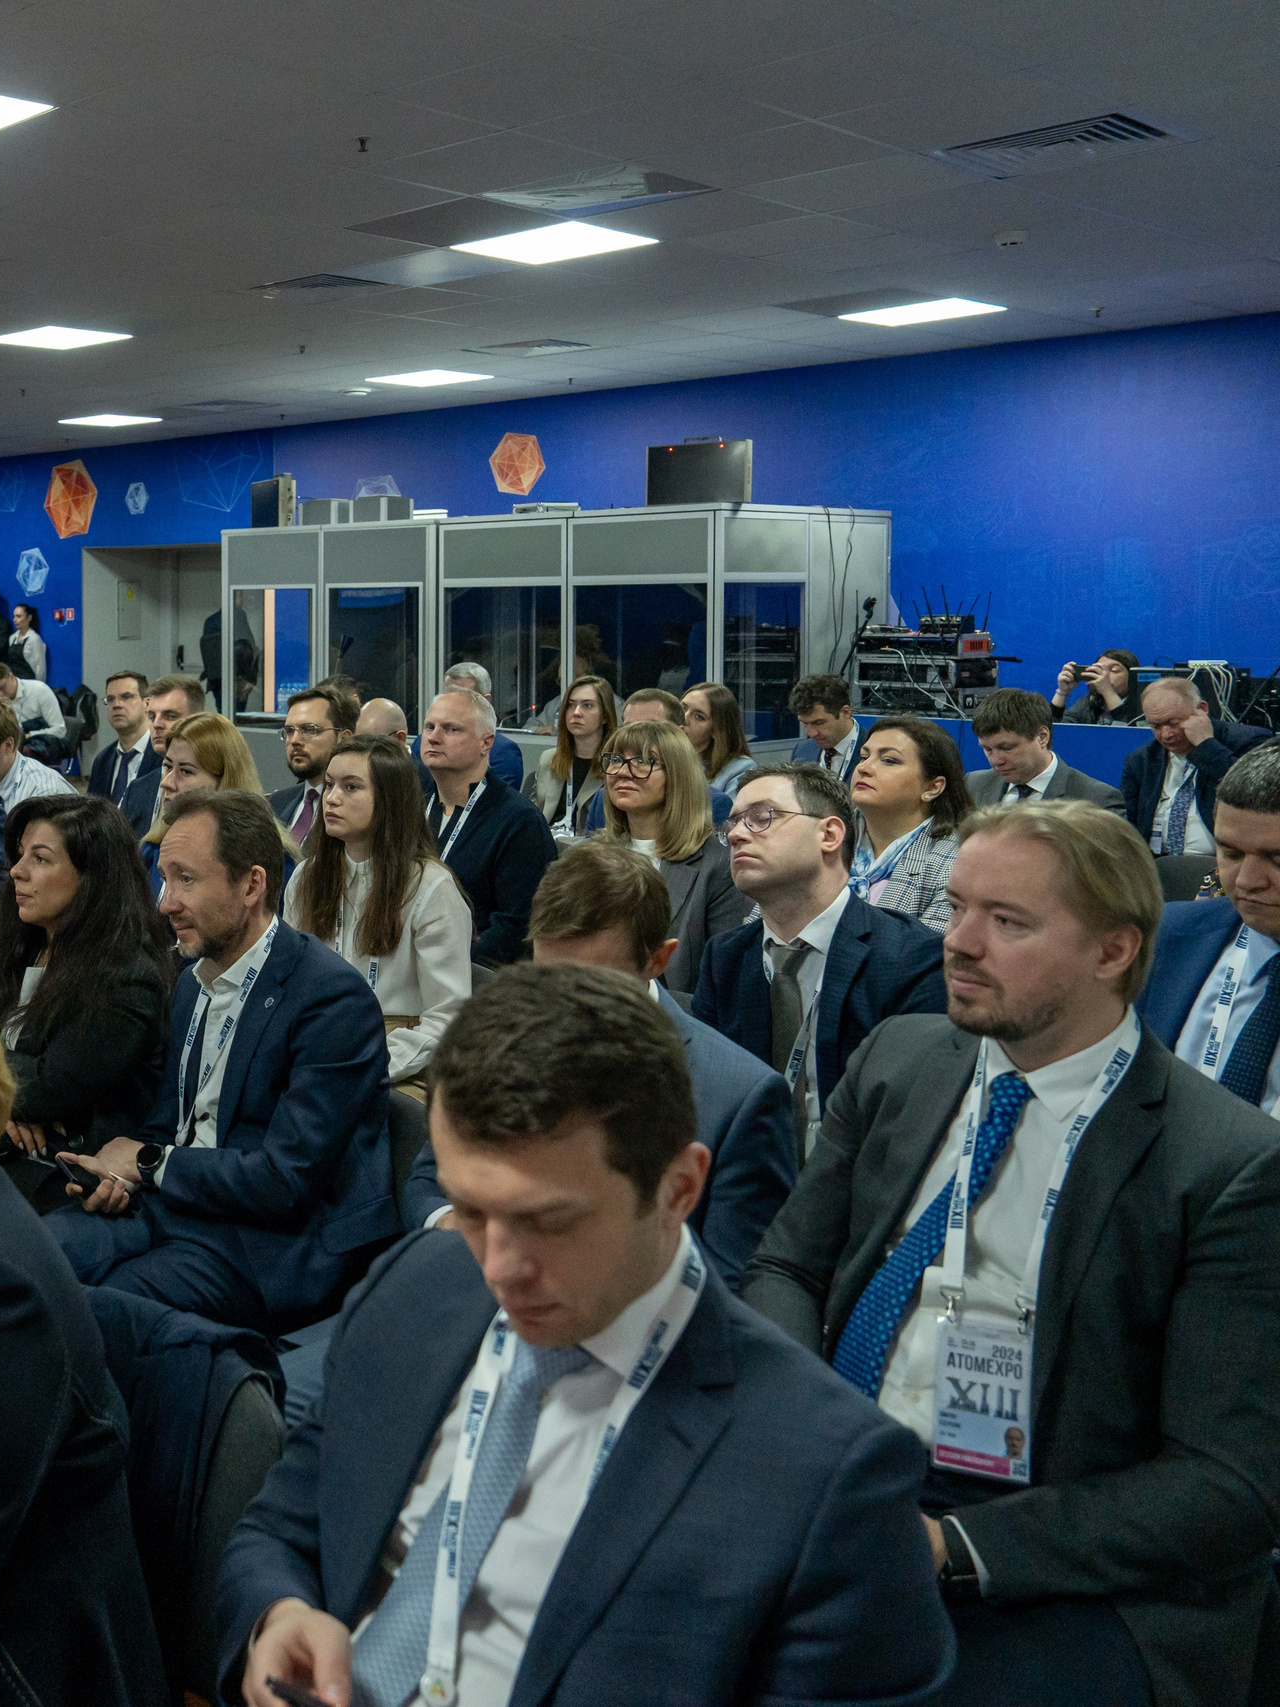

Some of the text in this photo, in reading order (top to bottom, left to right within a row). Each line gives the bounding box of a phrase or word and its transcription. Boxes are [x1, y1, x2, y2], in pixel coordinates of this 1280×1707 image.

[1218, 989, 1235, 1006] XIII
[1202, 1049, 1219, 1067] XIII
[949, 1209, 964, 1229] XIII
[991, 1344, 1023, 1362] 2024
[946, 1351, 1024, 1380] ATOMEXPO
